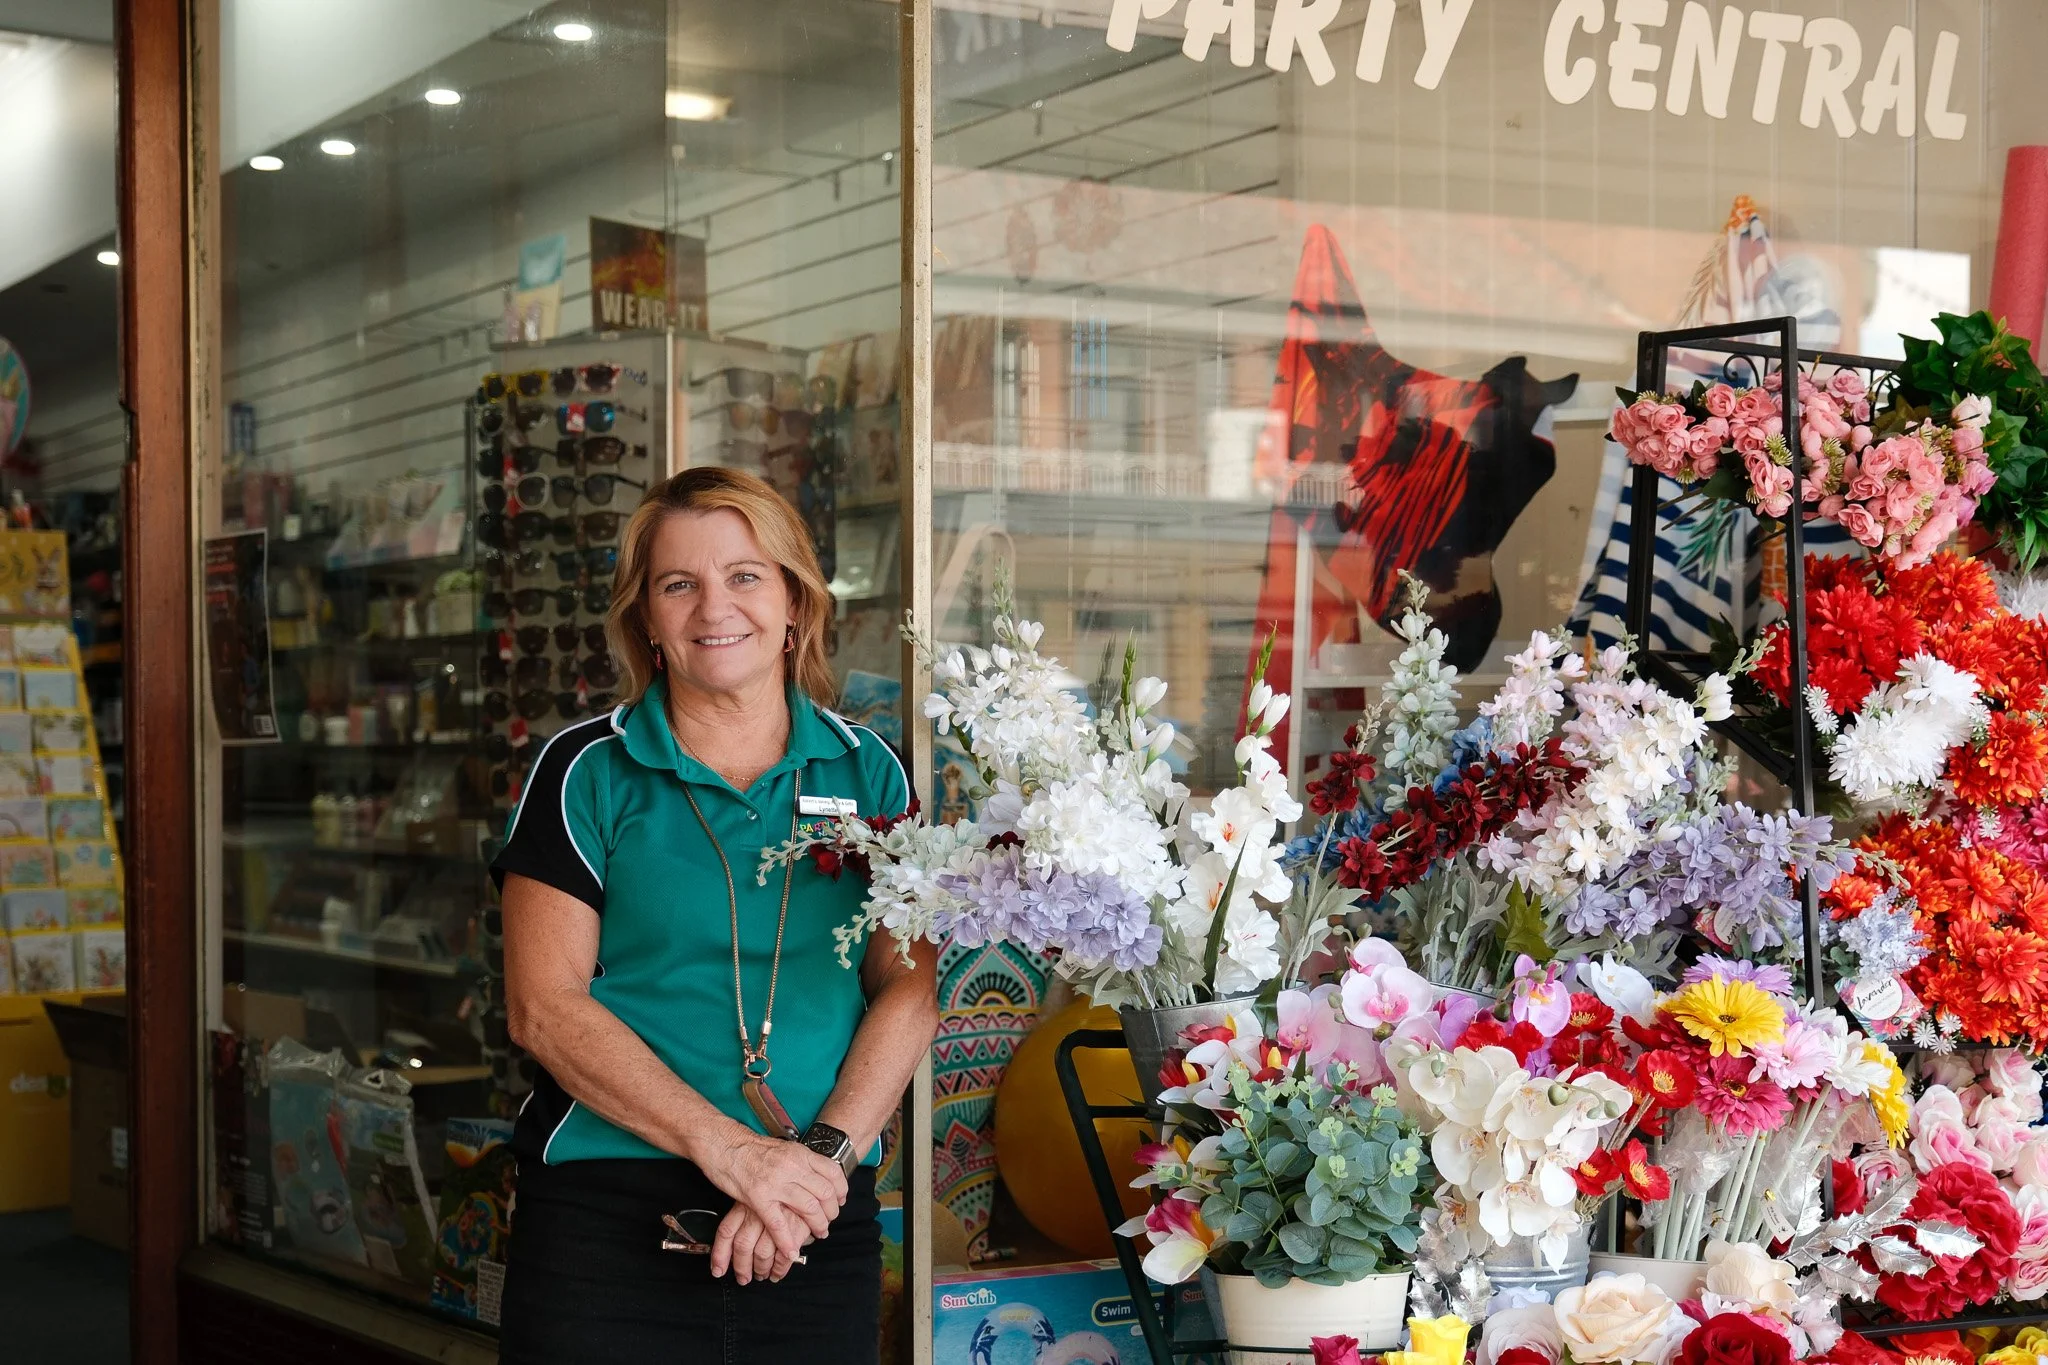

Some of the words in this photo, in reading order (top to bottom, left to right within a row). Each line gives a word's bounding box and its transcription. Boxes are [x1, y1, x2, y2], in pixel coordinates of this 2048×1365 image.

[1543, 0, 1967, 140] CENTRAL
[600, 289, 666, 332] WEAR
[943, 1290, 995, 1308] SunClub
[1101, 1304, 1131, 1317] Swim
